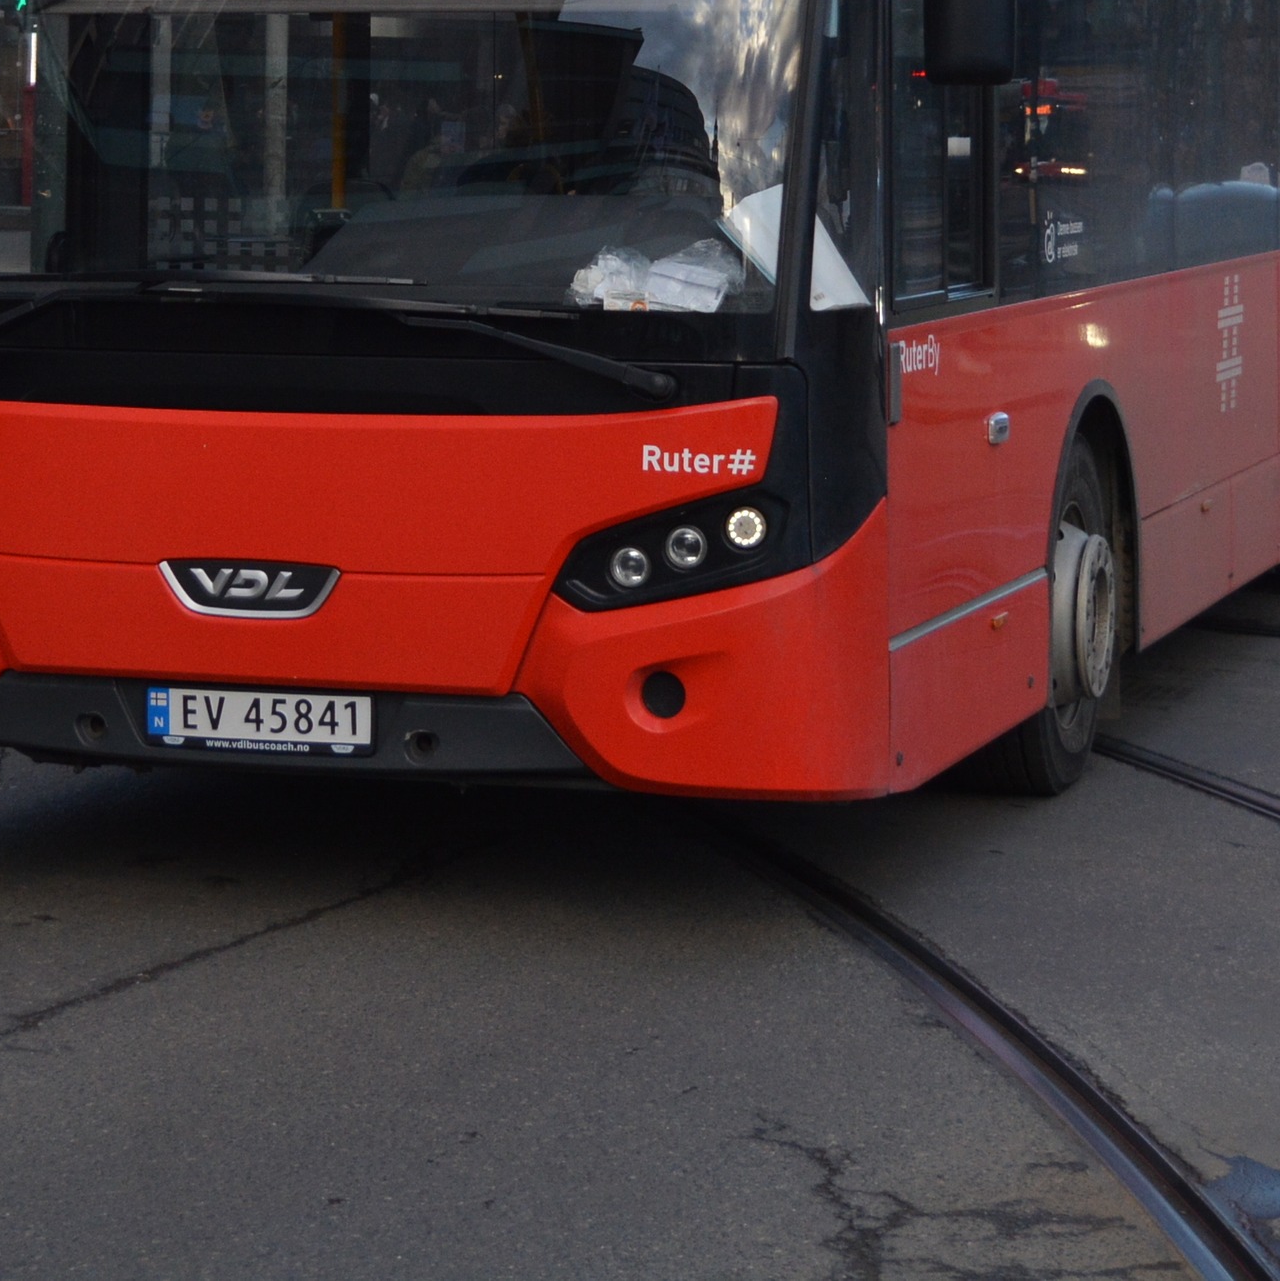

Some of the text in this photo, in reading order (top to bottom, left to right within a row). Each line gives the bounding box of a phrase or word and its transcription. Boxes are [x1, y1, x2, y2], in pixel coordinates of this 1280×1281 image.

[642, 443, 757, 476] Ruter#
[189, 567, 304, 600] VDL
[154, 694, 358, 736] N EV 45841
[205, 738, 310, 753] www.vdlbuscoach.no
